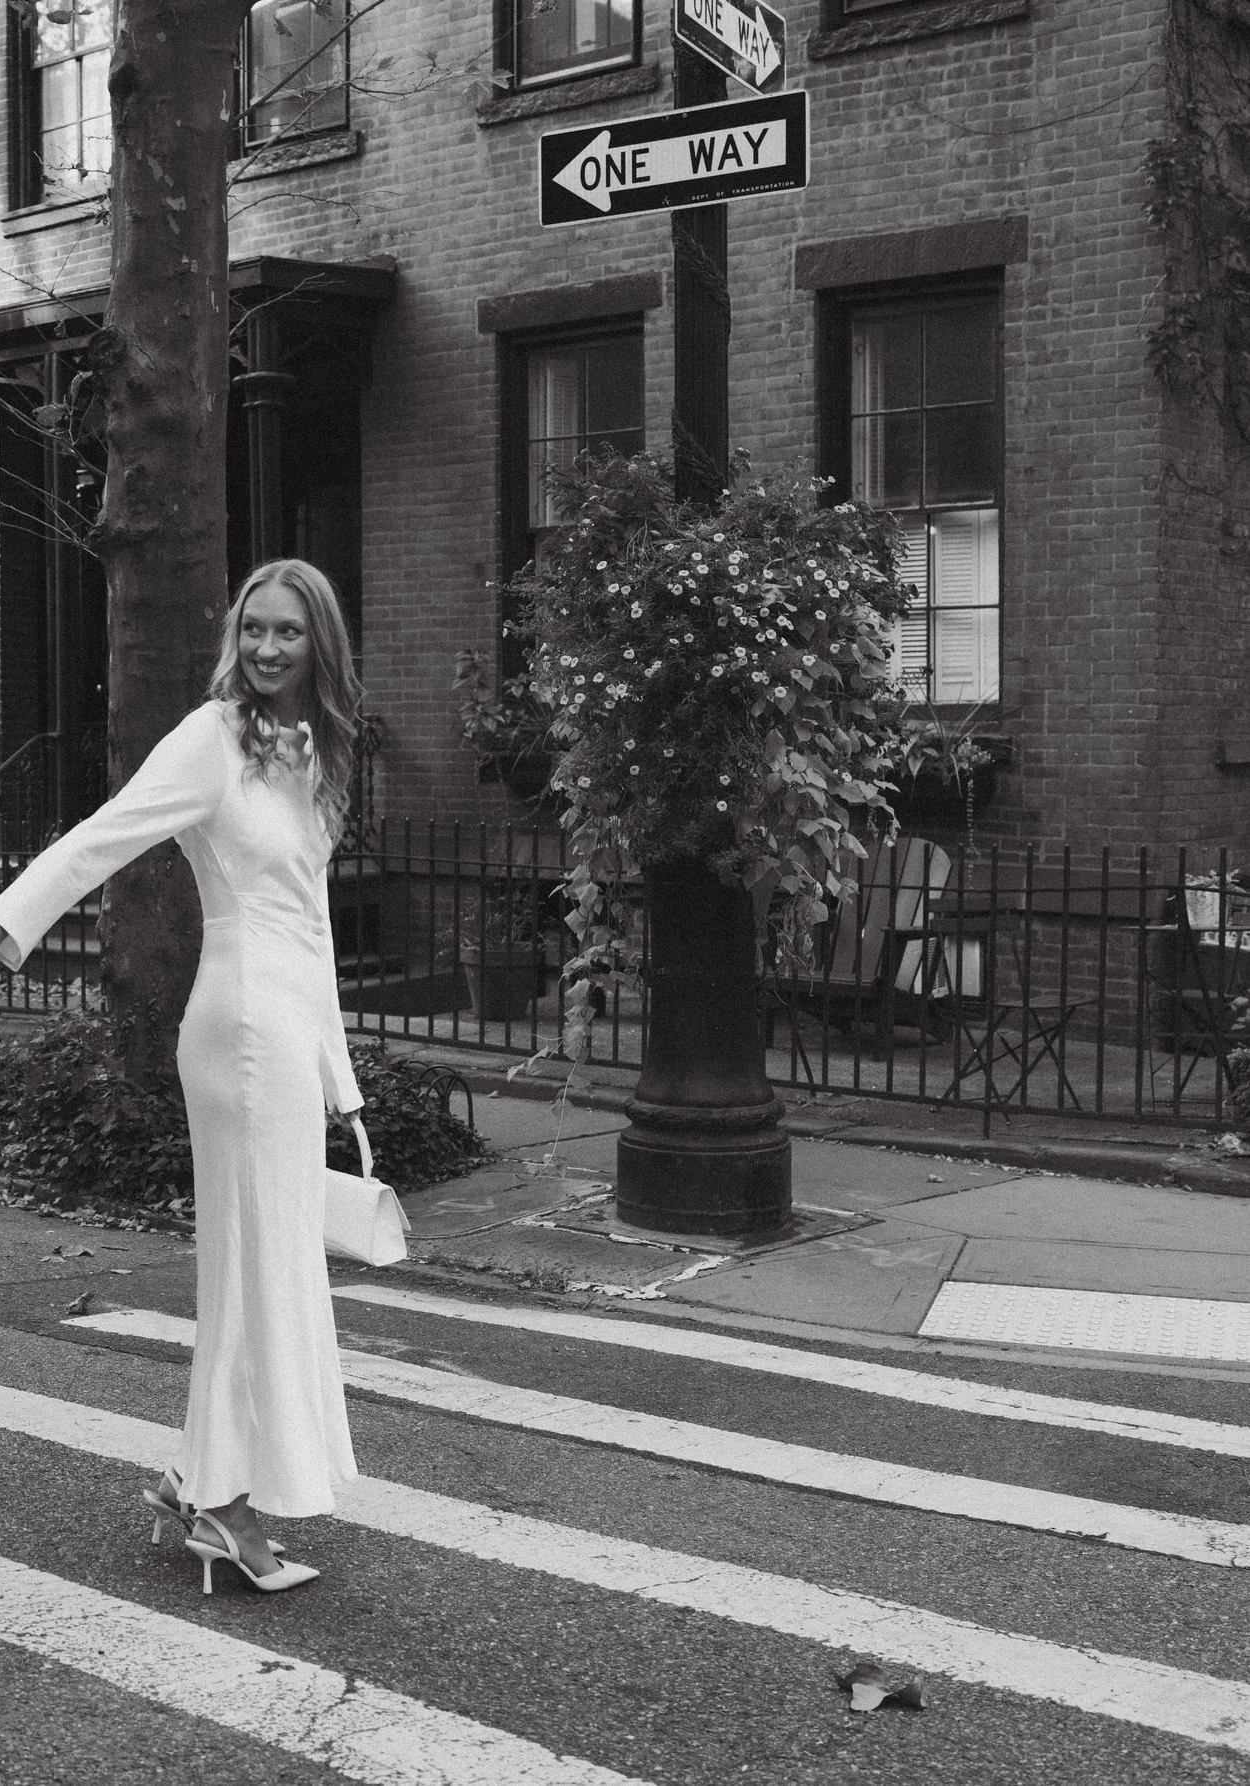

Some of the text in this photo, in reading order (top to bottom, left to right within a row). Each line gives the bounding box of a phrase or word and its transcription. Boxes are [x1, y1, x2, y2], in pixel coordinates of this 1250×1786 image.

[693, 0, 724, 37] ONE
[738, 16, 770, 68] WAY
[580, 127, 769, 190] ONE WAY
[691, 193, 709, 201] DEPT
[732, 181, 795, 195] TRANSPORTATION
